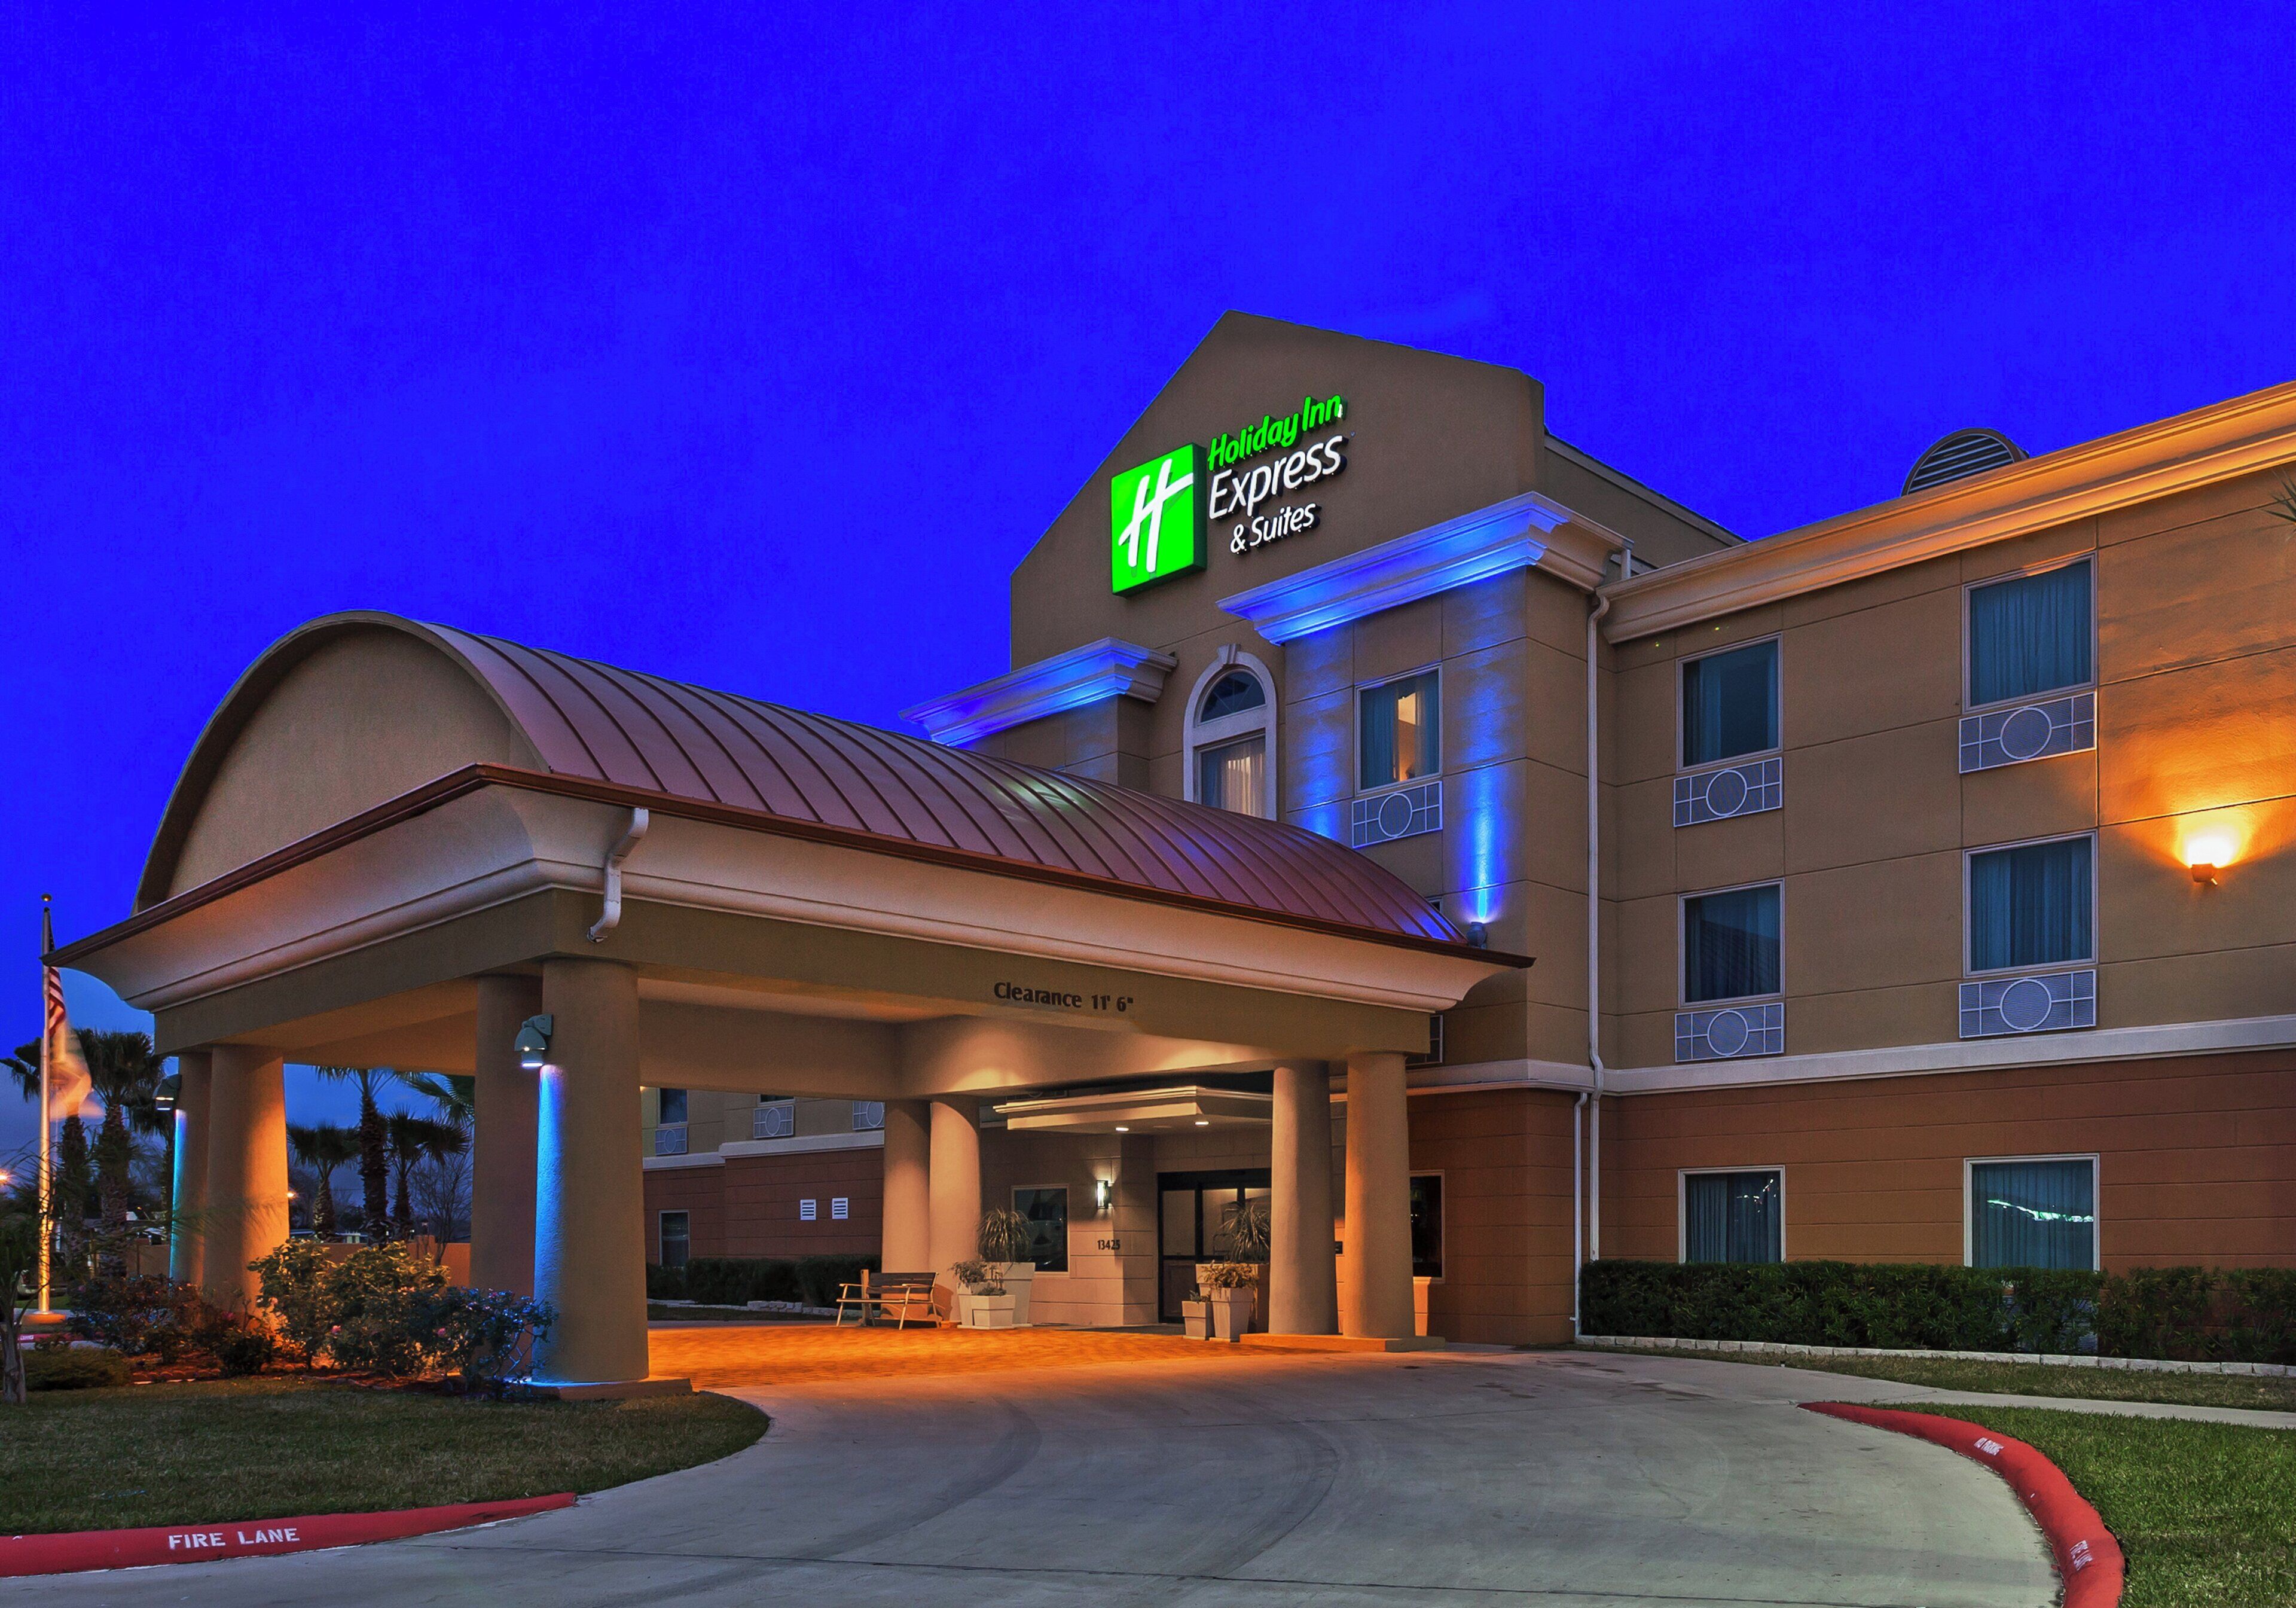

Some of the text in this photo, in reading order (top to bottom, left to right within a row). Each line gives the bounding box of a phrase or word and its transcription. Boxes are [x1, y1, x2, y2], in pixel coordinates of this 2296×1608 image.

[1207, 395, 1343, 471] Holiday Inn
[1209, 435, 1343, 520] Express
[1230, 503, 1316, 553] & Suites
[994, 982, 1134, 1012] Clearance 11' 6"
[1097, 1240, 1120, 1250] 13425
[169, 1528, 300, 1549] FIRE LANE
